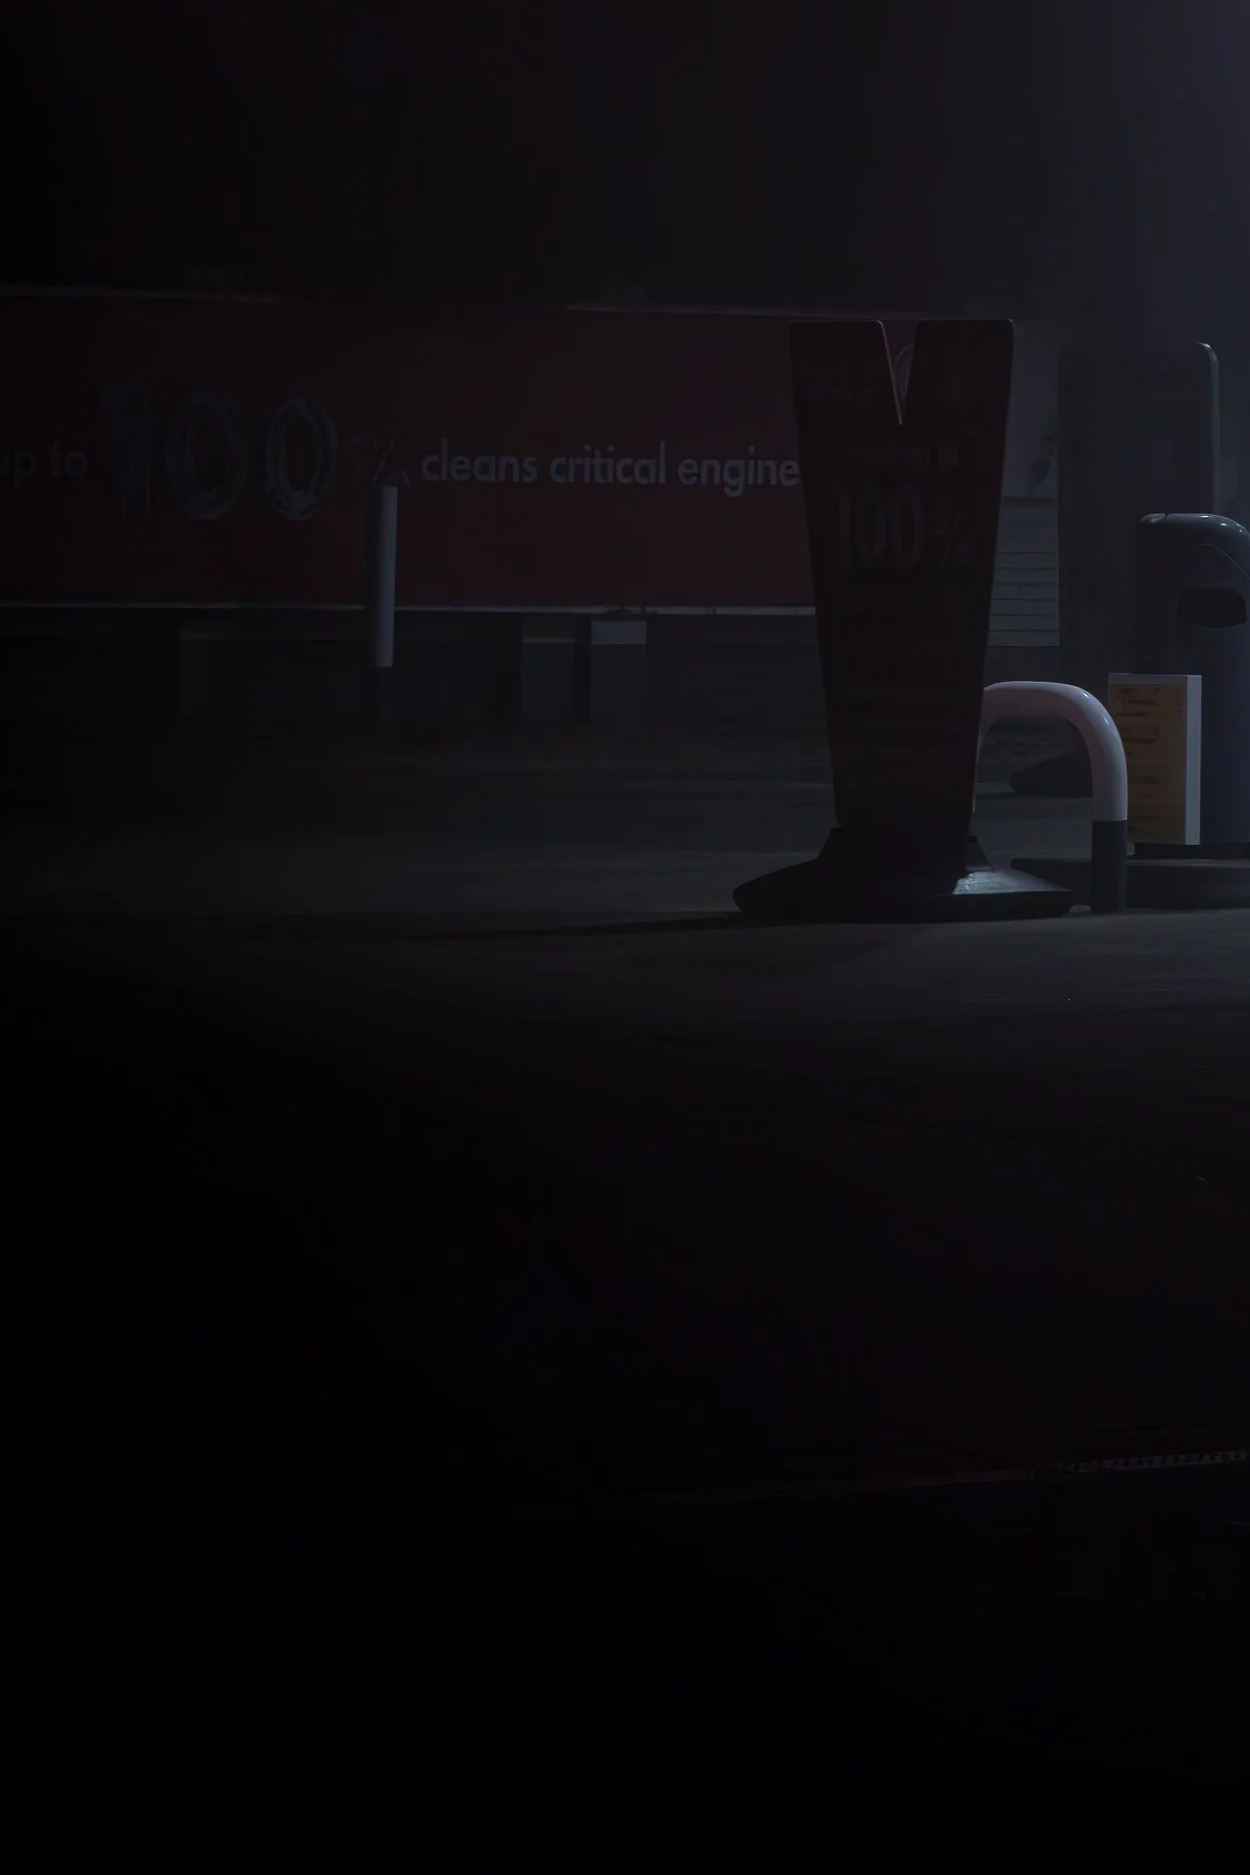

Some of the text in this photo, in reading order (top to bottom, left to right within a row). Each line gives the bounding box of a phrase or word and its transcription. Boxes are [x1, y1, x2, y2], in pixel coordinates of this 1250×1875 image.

[50, 441, 90, 480] to
[421, 436, 539, 484] cleans
[549, 439, 666, 485] critical
[677, 444, 801, 498] engine
